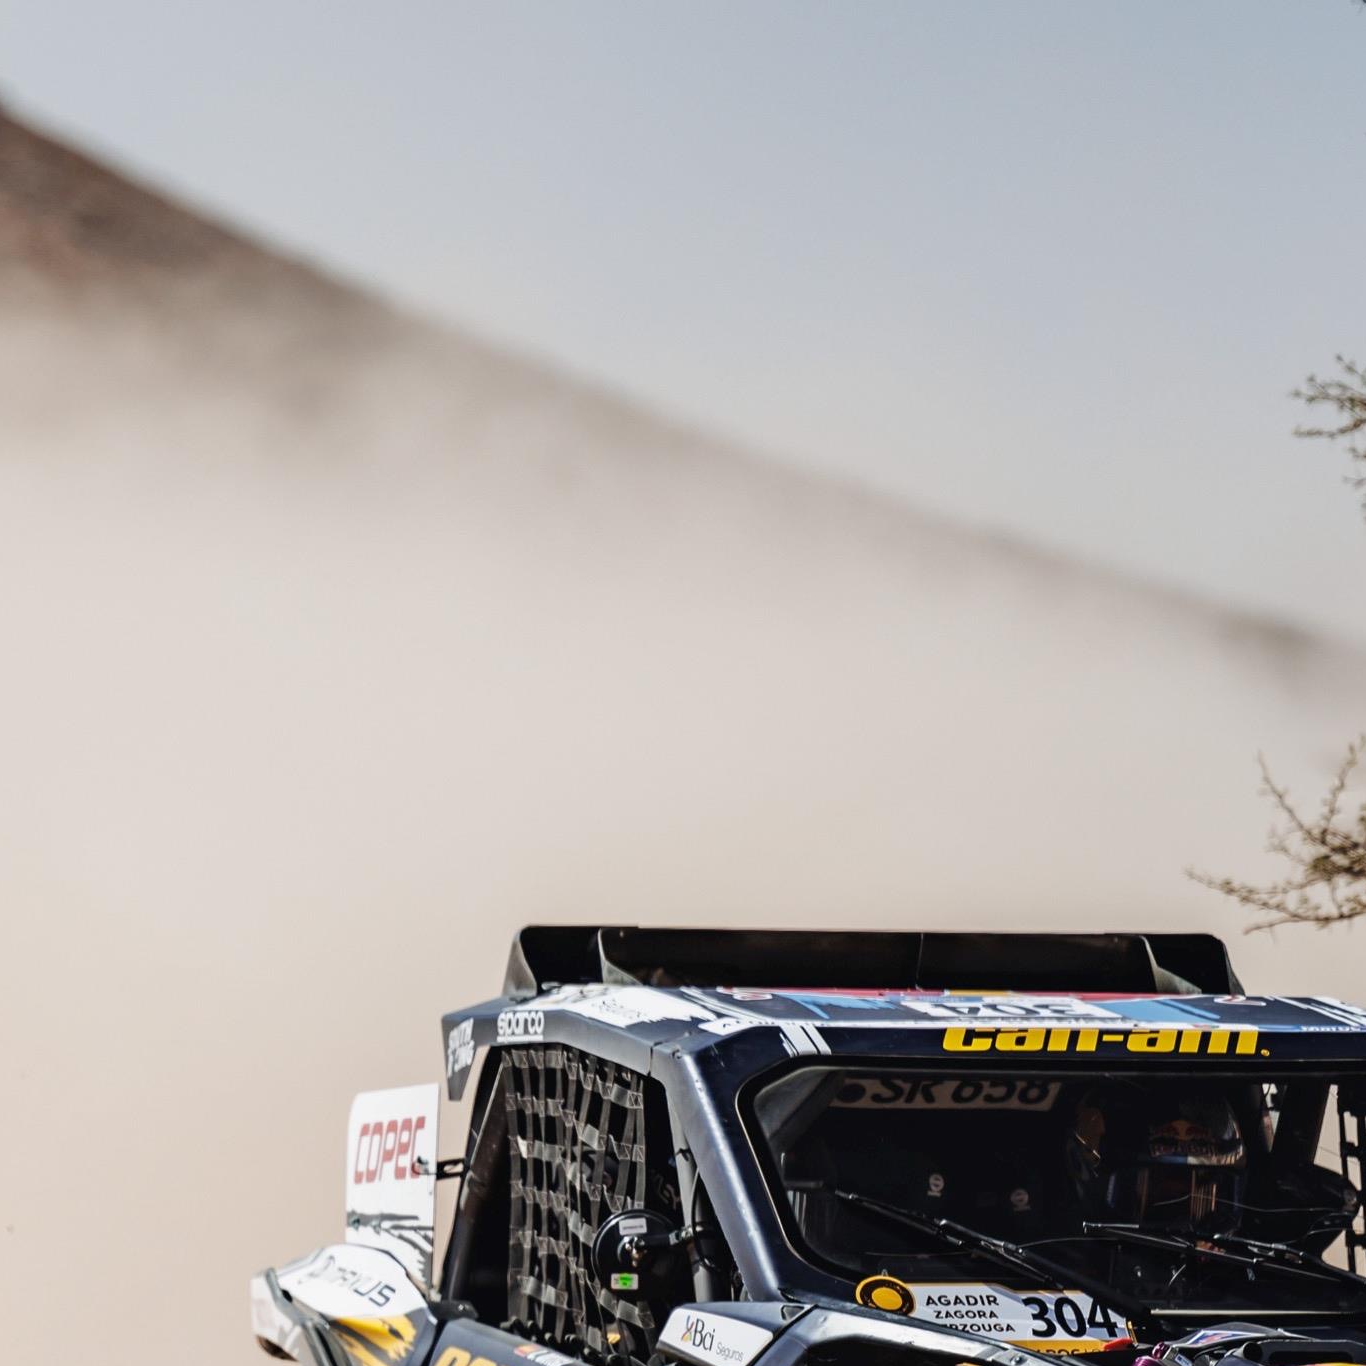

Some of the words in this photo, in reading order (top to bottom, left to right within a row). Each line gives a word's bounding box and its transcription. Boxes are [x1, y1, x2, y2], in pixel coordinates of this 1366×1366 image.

[497, 1010, 545, 1042] sparco
[925, 1295, 1000, 1306] AGADIR
[934, 1310, 999, 1320] ZAGORA
[1022, 1296, 1119, 1339] 304
[944, 1323, 1016, 1333] RZOUGA
[692, 1318, 716, 1352] Bci
[716, 1342, 744, 1363] Seguros
